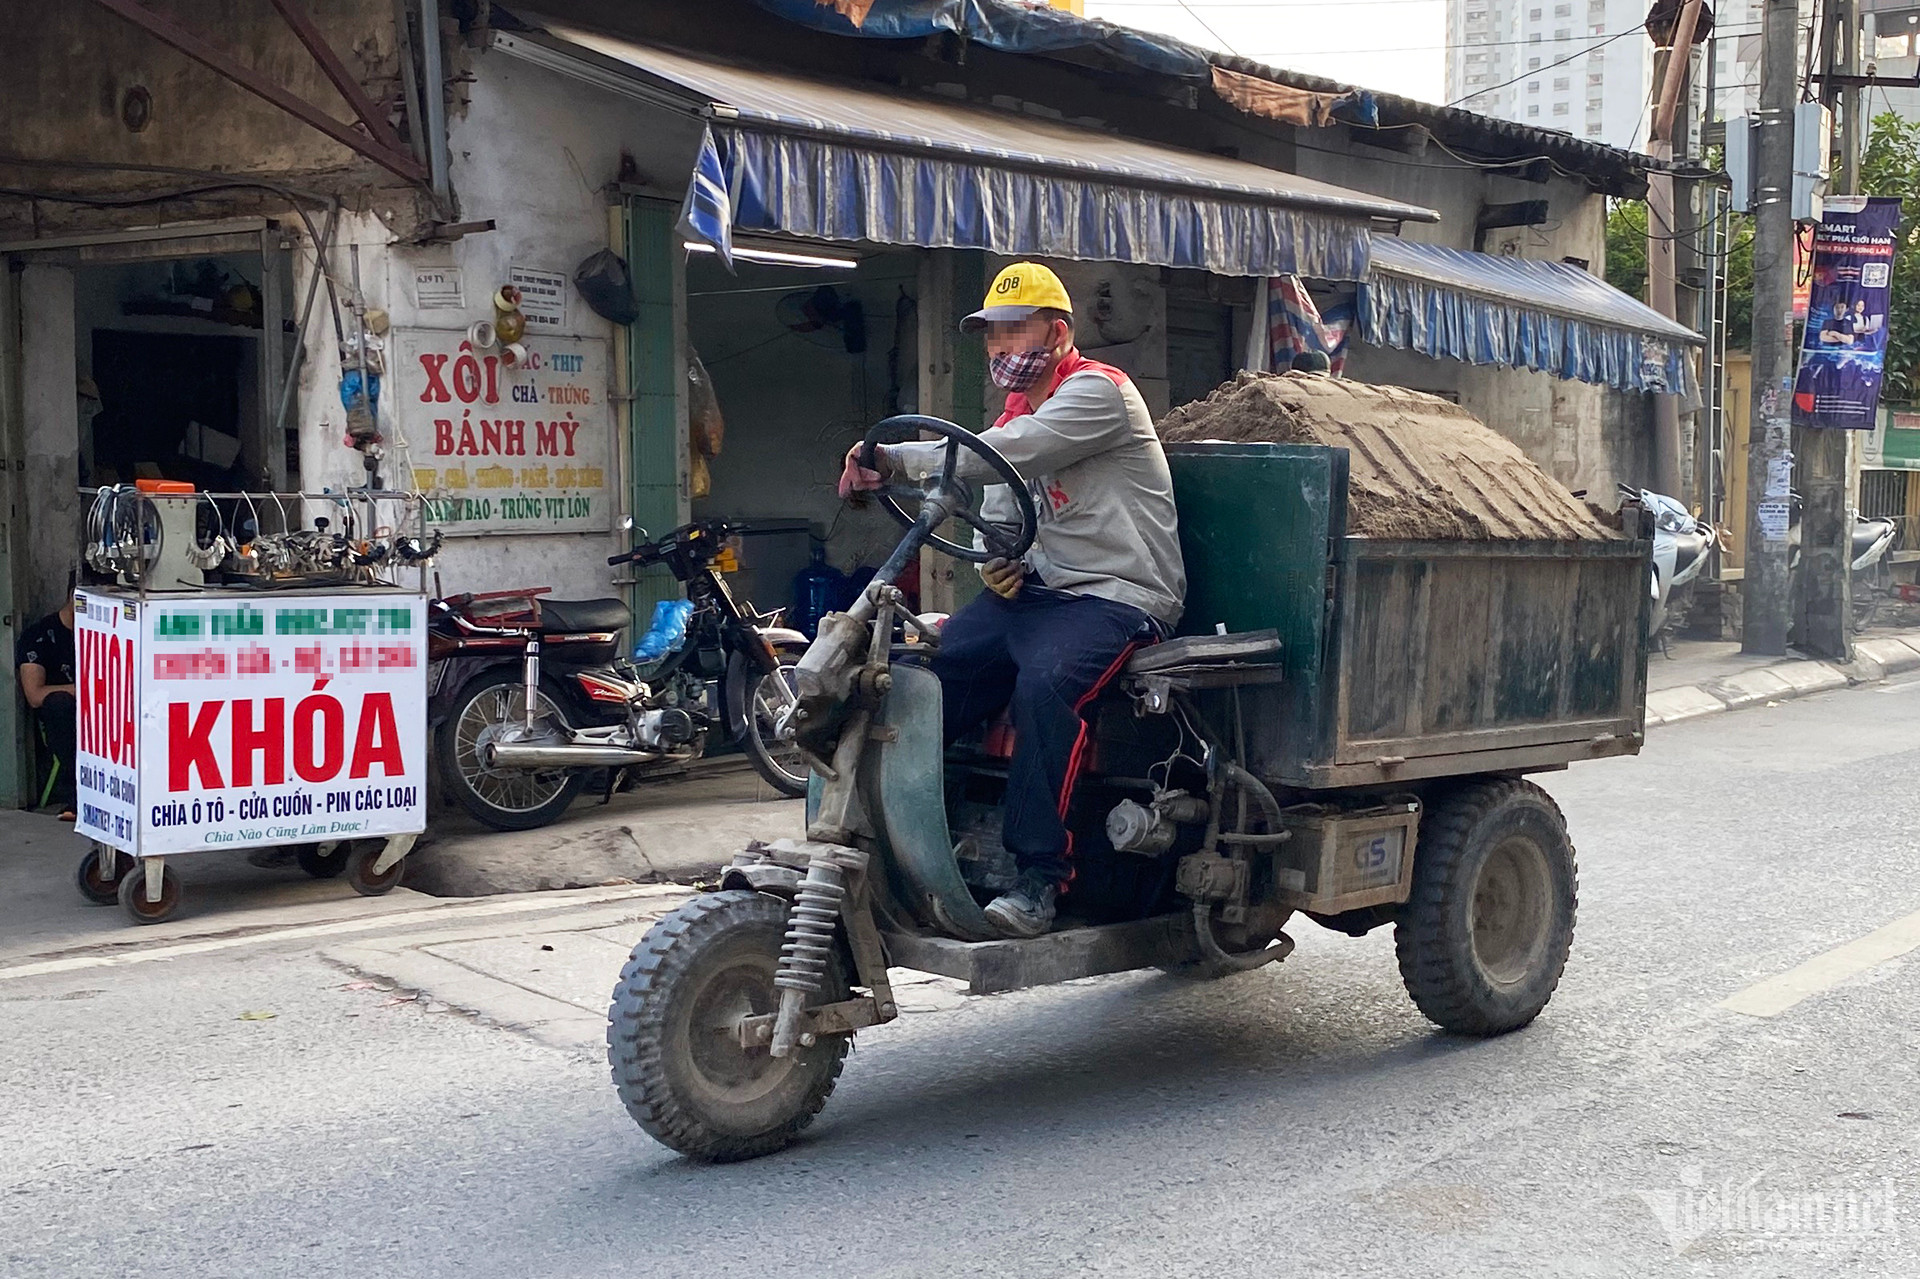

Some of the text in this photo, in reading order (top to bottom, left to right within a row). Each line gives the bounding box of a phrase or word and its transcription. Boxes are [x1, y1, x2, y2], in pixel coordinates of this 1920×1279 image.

[1820, 224, 1856, 234] SMART
[1832, 234, 1851, 243] PHÁ
[1852, 235, 1869, 245] GIỚI
[1871, 237, 1891, 247] HẠN
[419, 340, 500, 404] XÔI
[551, 354, 584, 377] THỊT
[512, 378, 538, 403] CHẢ
[548, 383, 590, 405] TRỨNG
[434, 409, 580, 457] BÁNH MỲ
[465, 498, 491, 520] BAO
[501, 491, 542, 520] TRỨNG
[545, 497, 566, 525] VỊT
[79, 606, 136, 769] KHÓA
[168, 679, 405, 792] KHÓA
[152, 800, 187, 827] CHÌA
[192, 798, 202, 824] Ô
[206, 796, 224, 823] TÔ
[240, 791, 269, 820] CỬA
[273, 787, 312, 817] CUỐN
[327, 791, 350, 813] PIN
[355, 785, 383, 811] CÁC
[387, 786, 416, 812] LOẠI
[204, 831, 233, 844] Chìa
[236, 828, 263, 841] Nào
[266, 825, 298, 839] Cũng
[301, 823, 327, 836] Làm
[330, 820, 362, 834] Được
